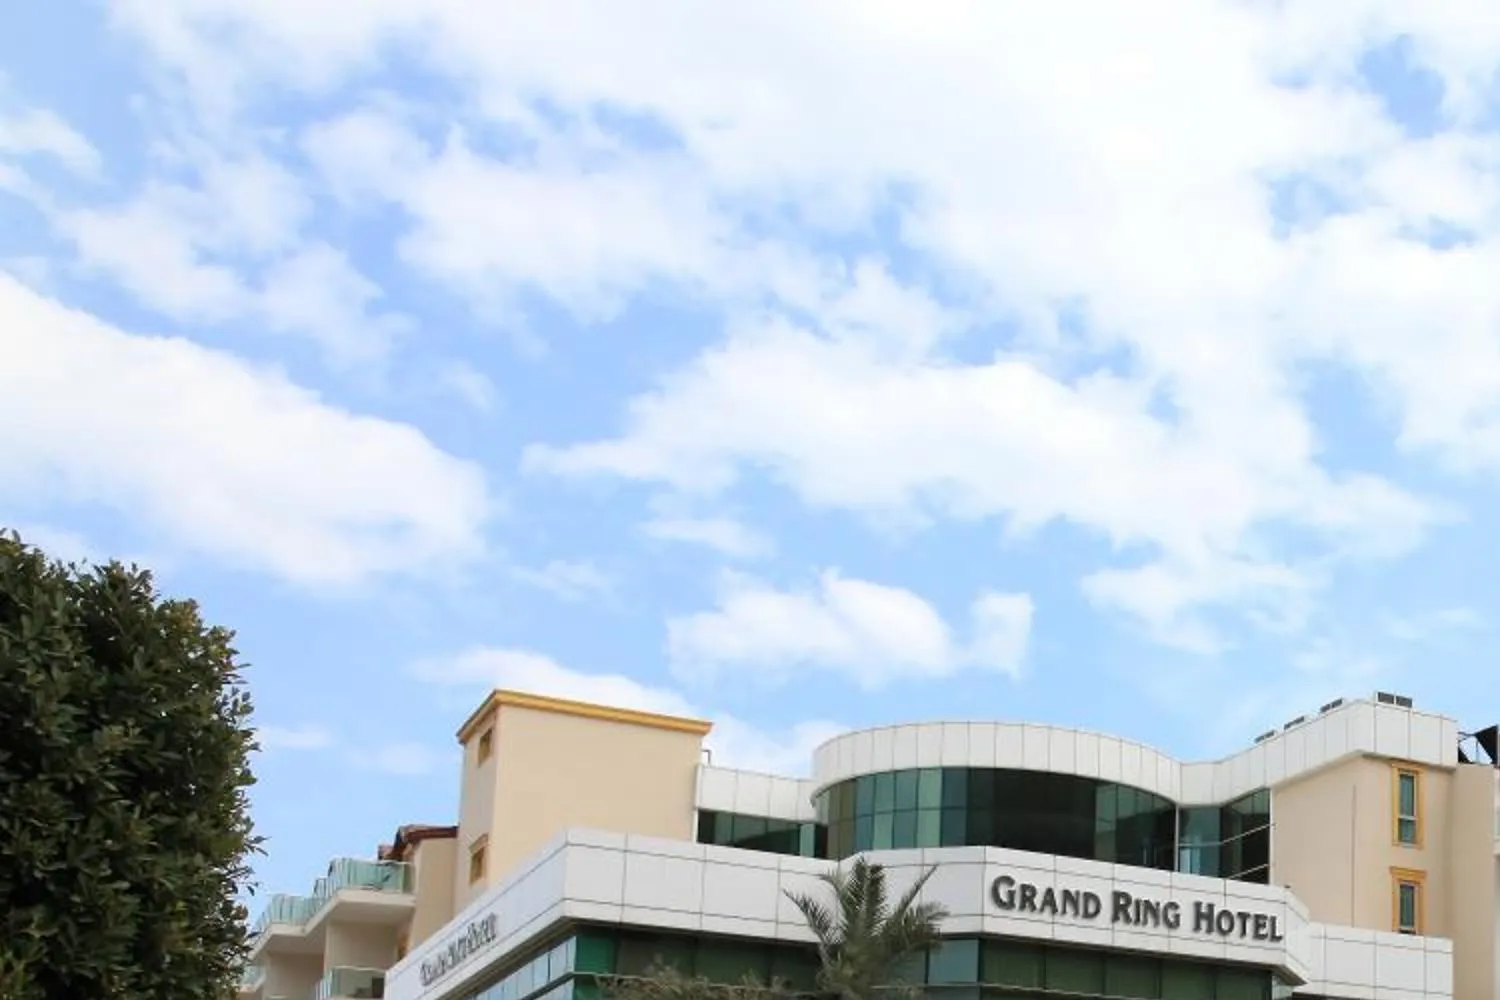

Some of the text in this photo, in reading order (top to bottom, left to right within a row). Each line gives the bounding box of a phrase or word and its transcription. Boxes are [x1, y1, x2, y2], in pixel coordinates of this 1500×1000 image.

[991, 875, 1283, 942] GRAND RING HOTEL
